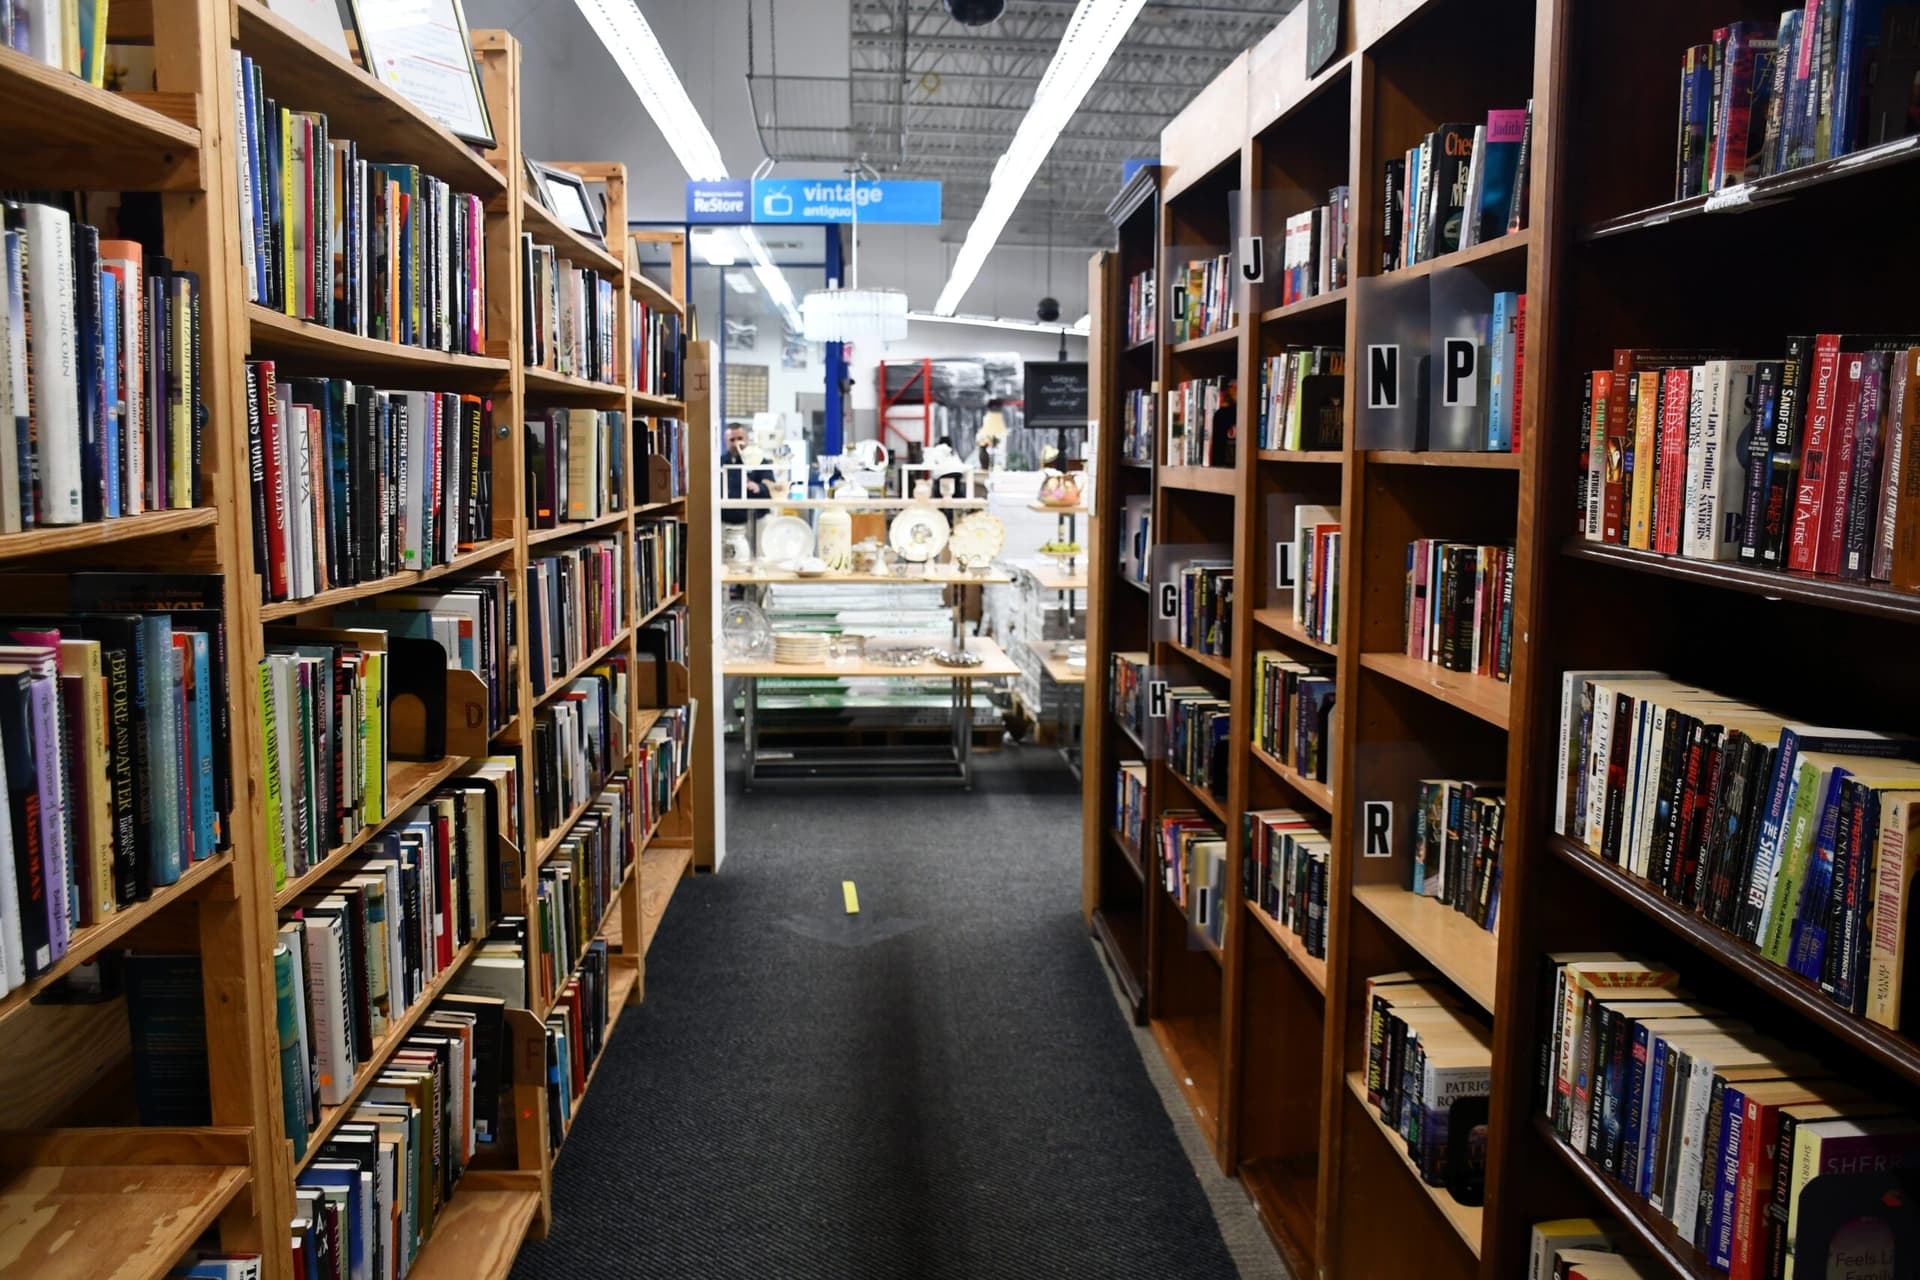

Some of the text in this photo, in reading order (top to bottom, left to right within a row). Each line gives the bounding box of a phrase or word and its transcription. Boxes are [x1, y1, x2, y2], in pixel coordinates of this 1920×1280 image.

[694, 198, 744, 213] ReStore
[803, 183, 883, 206] vintage
[803, 206, 852, 218] antiguo
[1243, 239, 1261, 280] J
[54, 221, 70, 377] IMMORTAL UNICORN
[1174, 286, 1186, 319] D
[95, 344, 105, 397] BECK
[183, 311, 191, 380] ELIZABETH
[1371, 347, 1397, 405] N
[1446, 340, 1474, 403] P
[1860, 375, 1872, 419] SHAARA
[1896, 377, 1906, 415] Spencer
[1595, 399, 1605, 441] SCIMITAR
[1638, 398, 1649, 443] SANDS
[1666, 375, 1680, 434] SANDS
[1677, 383, 1686, 426] LYNSAY
[1689, 389, 1697, 448] SANDERS
[1695, 389, 1704, 448] Lawrence
[1775, 359, 1797, 445] JOHN SANDFORD
[1810, 366, 1833, 445] Daniel Silva
[272, 424, 282, 468] LARRY
[400, 405, 408, 457] STEPHEN
[470, 410, 481, 497] PATRICIA CORNWELL
[1655, 394, 1665, 464] LYNSAY SANDS
[1703, 414, 1717, 490] Lucy Bending
[251, 438, 264, 483] TORCH
[300, 430, 309, 505] NAPA
[1831, 402, 1856, 541] THE CLASS ERICH SEGAL
[273, 471, 285, 530] COLLINS
[389, 484, 397, 515] SIGNS
[1589, 470, 1600, 534] PATRICK ROBINSON
[1697, 494, 1708, 540] SANDERS
[1705, 495, 1715, 540] Lawrence
[1747, 491, 1759, 546] SANDFORD
[1793, 484, 1812, 546] Kill Artist
[1811, 500, 1819, 516] The
[1853, 437, 1874, 550] GODS AND GENERALS
[1280, 544, 1295, 586] L
[1503, 547, 1516, 604] NICK PETRIE
[1162, 584, 1176, 617] G
[465, 703, 482, 728] D
[1151, 683, 1166, 714] H
[111, 657, 132, 811] BEFORE AND AFTER
[261, 668, 279, 800] PATRICIA CORNWELL
[1597, 736, 1606, 775] TRACY
[1779, 738, 1793, 781] CARSTEN
[1681, 744, 1700, 821] DEADLY FORCE
[1771, 782, 1785, 817] STROUD
[119, 816, 131, 856] BROWN
[1367, 803, 1390, 854] R
[1663, 778, 1683, 873] WALLACE STROBY
[1763, 820, 1779, 840] THE
[1793, 816, 1806, 848] DEAR
[1748, 838, 1774, 909] SHIMMER
[1875, 828, 1903, 957] FIVE PAST MIDNIGHT
[1779, 879, 1793, 923] NICHOLAS
[1772, 924, 1785, 957] SPARKS
[1841, 910, 1853, 980] WILLIAM STEVENSON
[1561, 988, 1575, 1079] HELL'S GATE
[1595, 1075, 1603, 1096] WHAT
[1631, 1062, 1643, 1128] LEON URIS
[1590, 1131, 1599, 1150] TRUE
[1703, 1098, 1723, 1191] NATURAL CAUSES
[1719, 1112, 1743, 1254] Cutting Edge Robert Walker
[1777, 1135, 1791, 1203] THE ECHO
[1706, 1193, 1714, 1225] JONATHAN
[1737, 1203, 1745, 1240] WAMBAUGH
[1836, 1252, 1877, 1267] Feels
